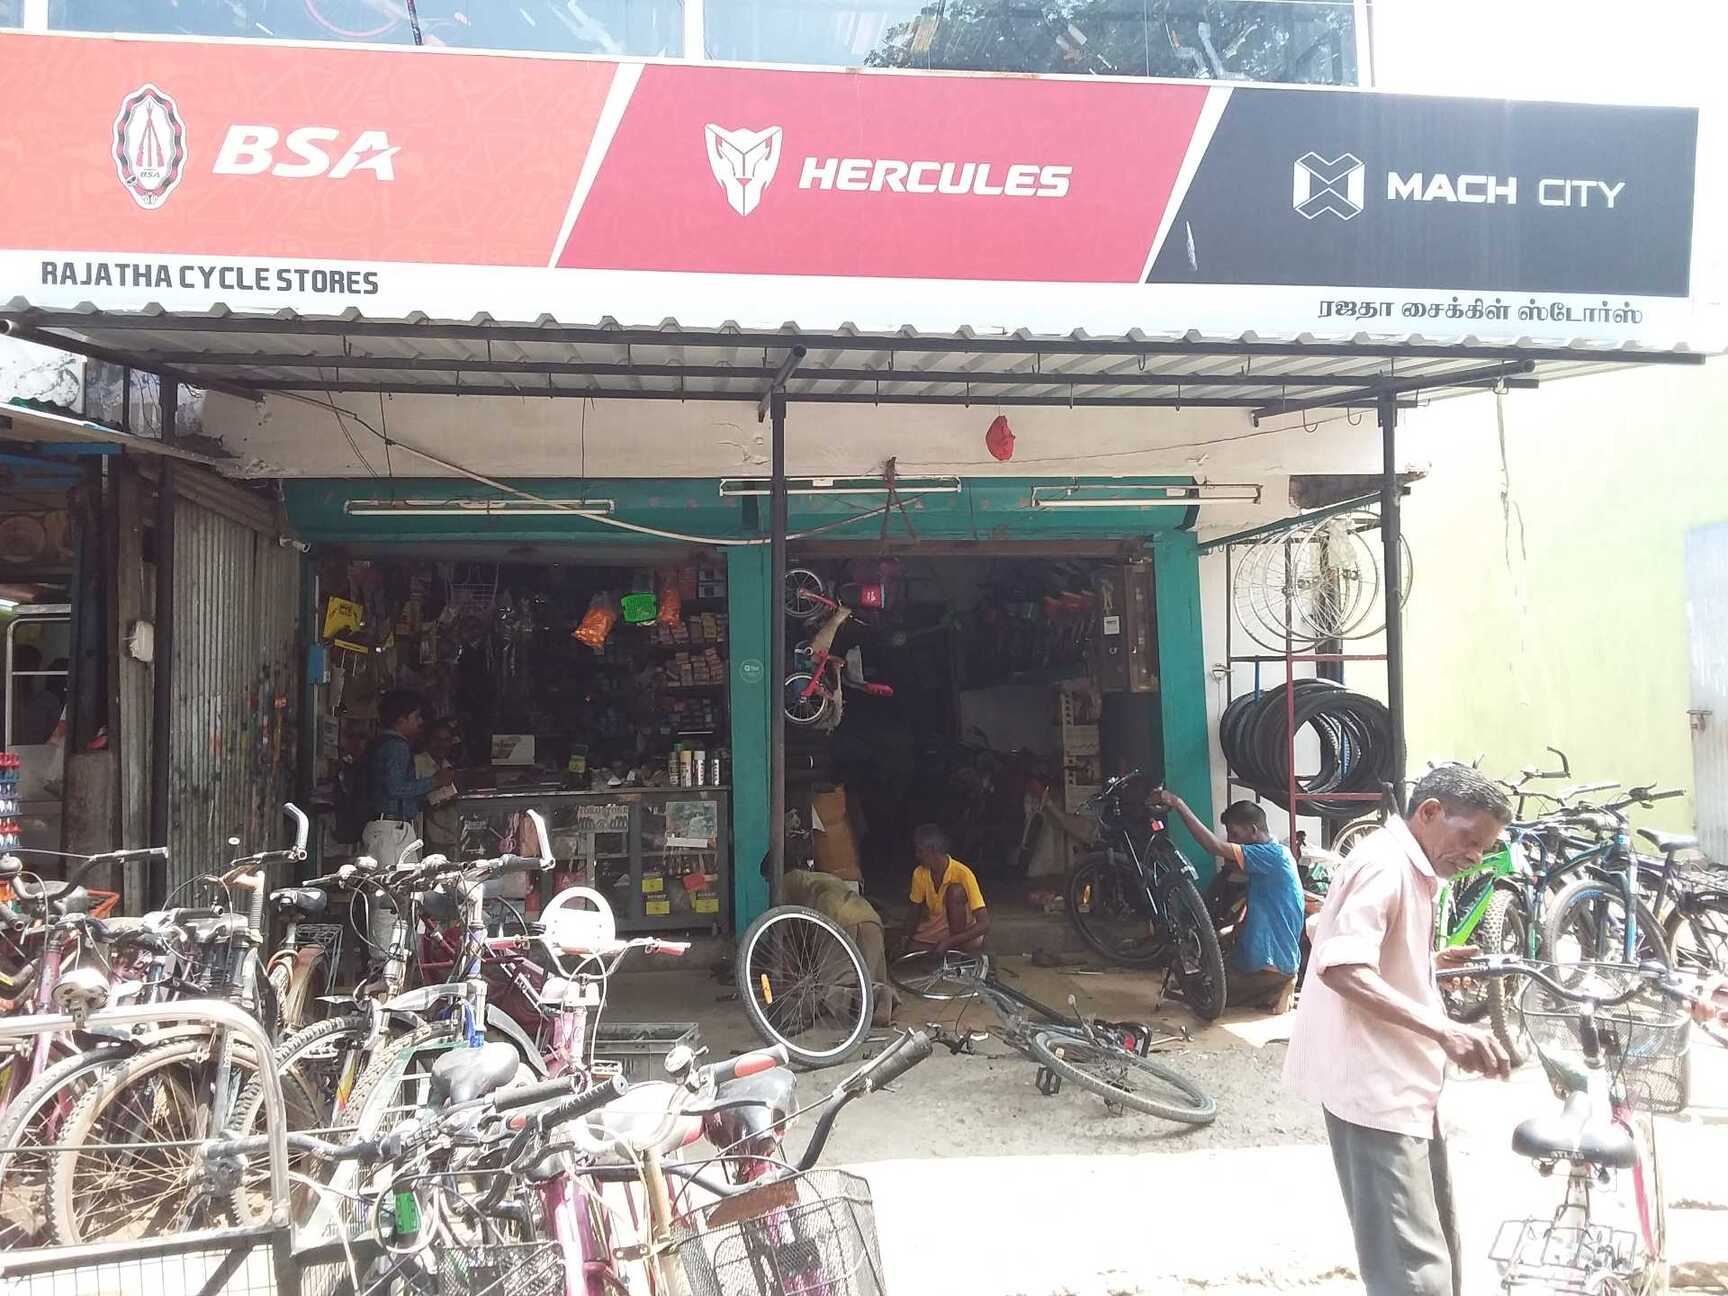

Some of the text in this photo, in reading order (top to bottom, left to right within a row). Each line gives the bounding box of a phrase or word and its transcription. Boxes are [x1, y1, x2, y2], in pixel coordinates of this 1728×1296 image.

[212, 124, 402, 182] BSA
[139, 170, 161, 178] BSA
[799, 156, 1073, 198] HERCULES
[1387, 171, 1626, 209] MACH CITY
[41, 261, 379, 295] RAJATHA CYCLE STORES
[1317, 296, 1643, 324] ரஜதா சைக்கிள் ஸ்டோர்ஸ்
